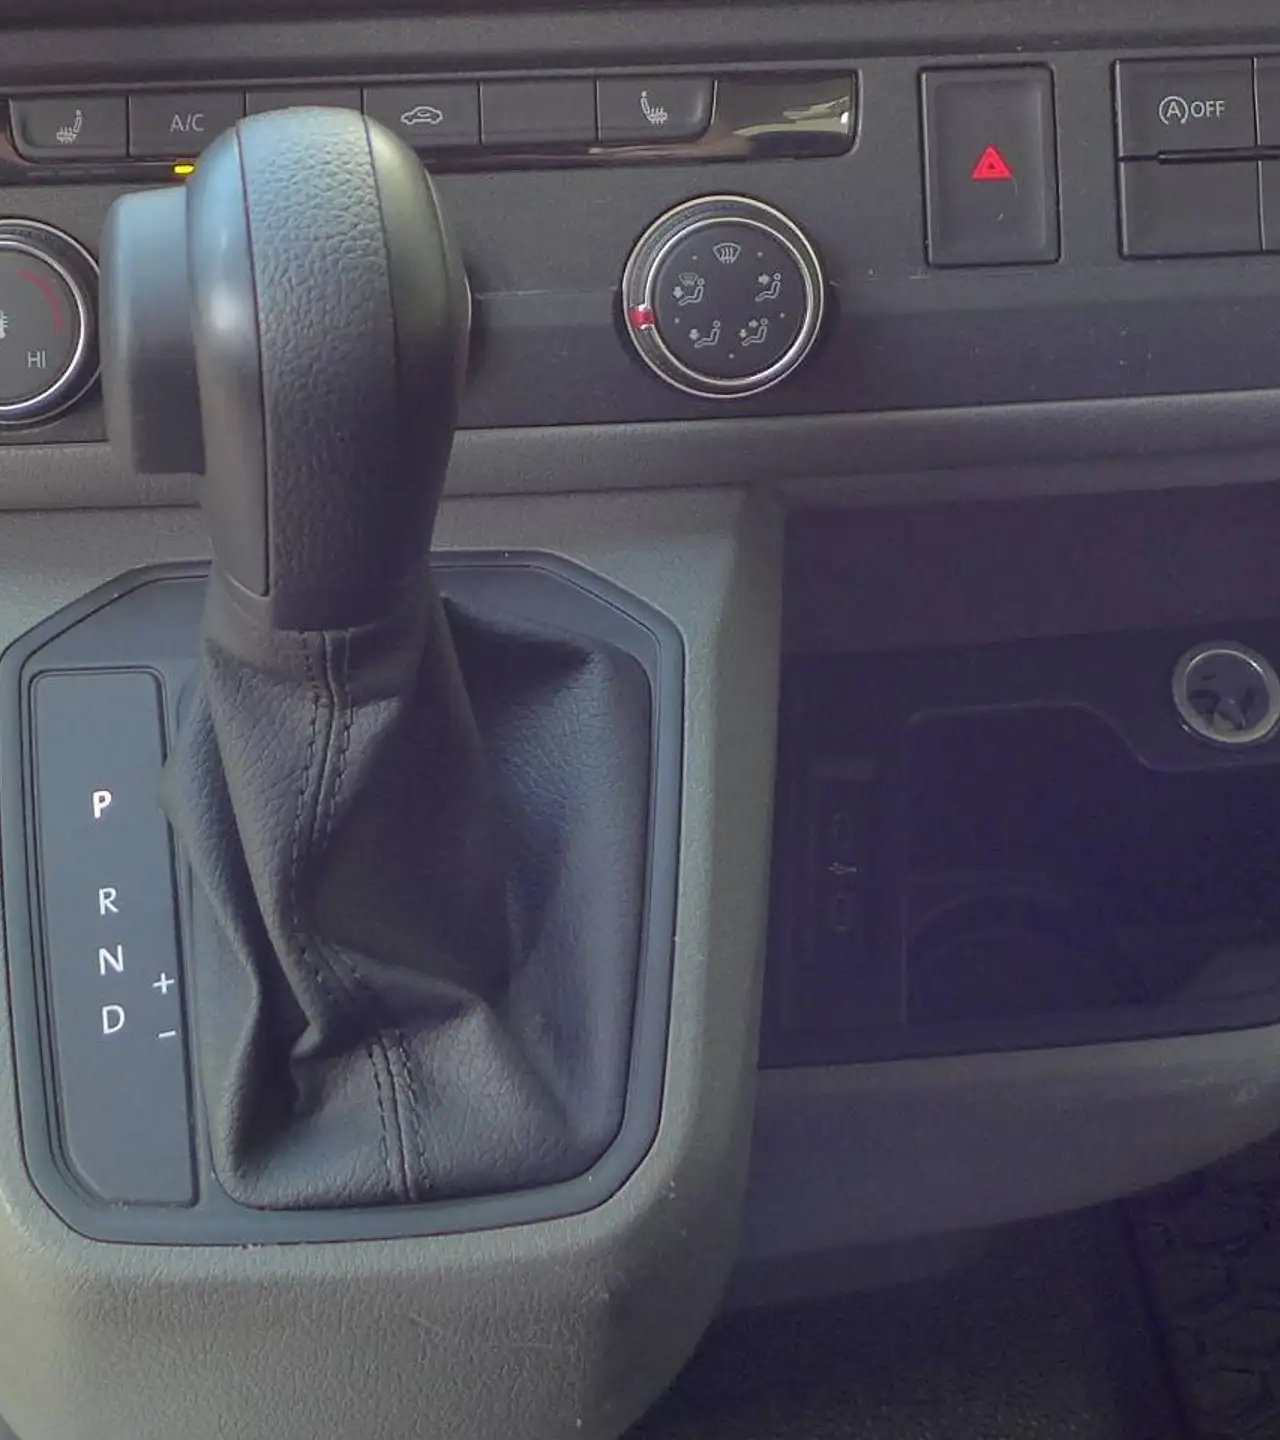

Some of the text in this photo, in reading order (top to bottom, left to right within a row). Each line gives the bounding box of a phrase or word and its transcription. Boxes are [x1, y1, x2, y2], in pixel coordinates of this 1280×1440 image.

[169, 114, 205, 133] A/C
[1190, 100, 1225, 119] OFF
[27, 351, 46, 369] HI
[92, 790, 112, 818] P
[98, 887, 120, 915] R
[99, 945, 124, 975] N
[102, 1005, 126, 1034] D
